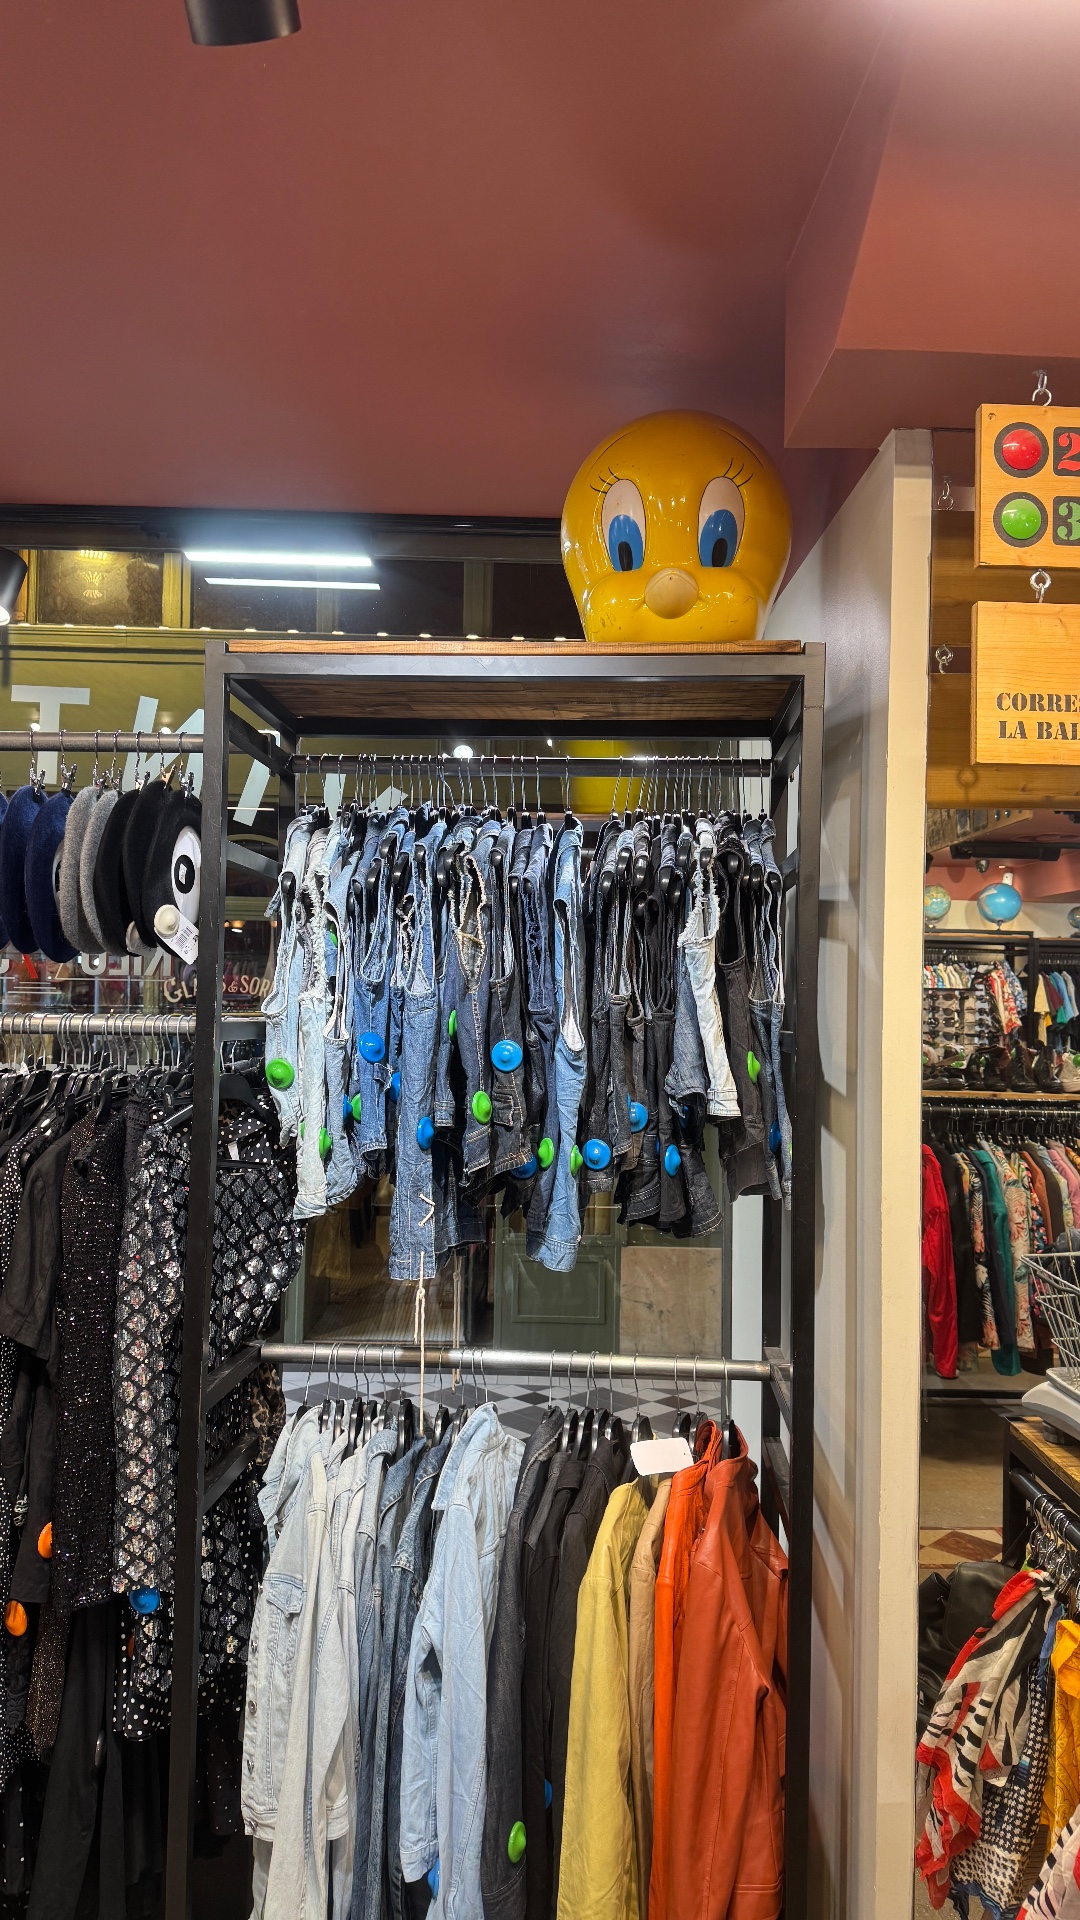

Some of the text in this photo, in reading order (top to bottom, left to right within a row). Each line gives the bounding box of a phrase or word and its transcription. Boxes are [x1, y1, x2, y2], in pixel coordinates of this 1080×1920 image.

[1057, 432, 1080, 471] 2
[1057, 502, 1080, 540] 3
[996, 692, 1080, 713] CORRE
[998, 721, 1028, 740] LA
